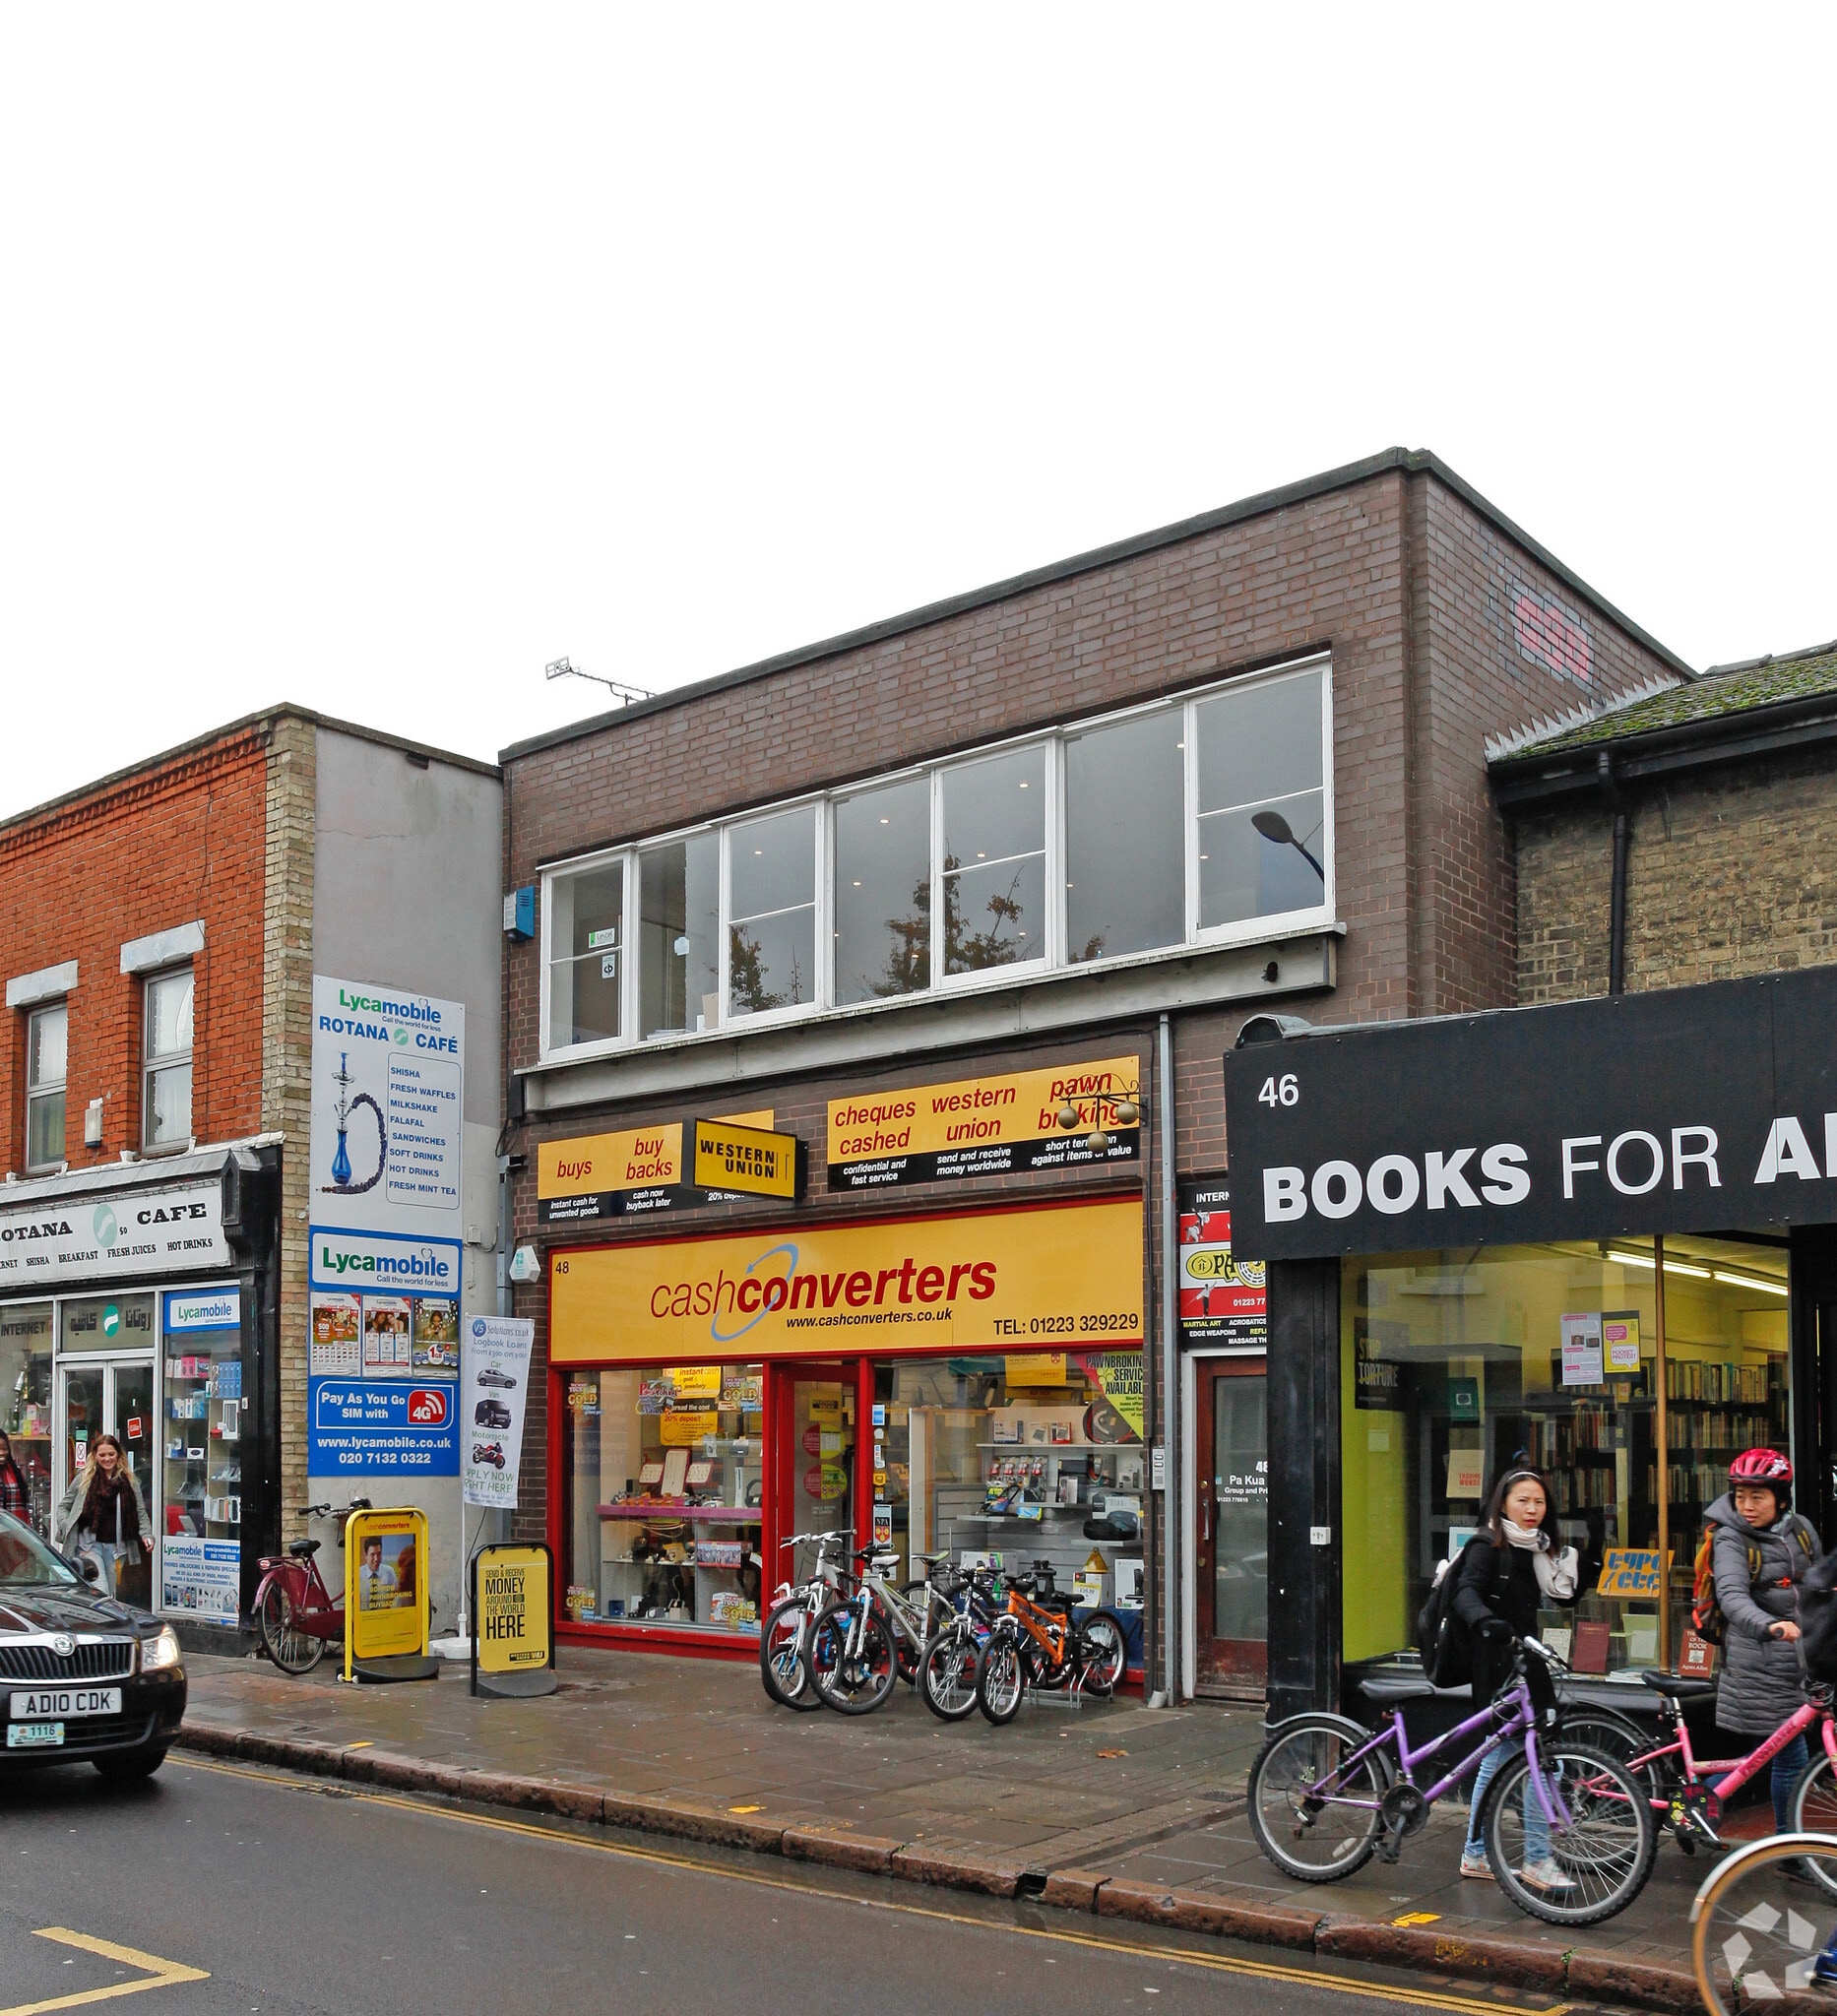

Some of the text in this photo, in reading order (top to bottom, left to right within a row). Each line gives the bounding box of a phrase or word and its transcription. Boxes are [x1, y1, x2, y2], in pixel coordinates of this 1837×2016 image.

[340, 988, 442, 1024] Lycamobile
[319, 1016, 458, 1053] ROTANA CAFÉ
[390, 1066, 420, 1079] SHISHA
[390, 1083, 456, 1101] FRESH WAFFLES
[1258, 1073, 1299, 1107] 46
[390, 1100, 438, 1113] MILKSHAKE
[835, 1073, 1112, 1129] cheques western pawn
[390, 1116, 425, 1128] FALAFAL
[840, 1101, 1121, 1156] cashed union brking
[392, 1132, 446, 1147] SANDWICHES
[1045, 1137, 1070, 1152] short
[634, 1137, 665, 1158] buy
[700, 1139, 774, 1164] WESTERN
[390, 1148, 444, 1162] SOFT DRINKS
[937, 1148, 1012, 1165] send and receive
[1032, 1153, 1064, 1166] against
[1066, 1151, 1093, 1162] items
[1107, 1145, 1132, 1157] value
[389, 1165, 440, 1177] HOT DRINKS
[556, 1159, 593, 1180] buys
[626, 1158, 672, 1180] backs
[726, 1159, 774, 1178] UNION
[843, 1159, 907, 1175] confidential and
[936, 1160, 1012, 1175] money worldwide
[1262, 1113, 1837, 1225] BOOKS FOR A
[852, 1171, 898, 1185] fast service
[389, 1180, 457, 1196] FRESH MINT TEA
[633, 1190, 649, 1200] cash
[550, 1196, 599, 1210] instant cash for
[708, 1192, 723, 1201] 20%
[625, 1198, 671, 1212] buyback later
[549, 1206, 600, 1220] unwanted goods
[0, 1203, 208, 1242] OTANA CAFE
[119, 1227, 128, 1235] 50
[26, 1237, 213, 1267] SHISHA BREAKFAST FRESH JUICES HOT DRINKS
[323, 1246, 449, 1277] Lycamobile
[555, 1261, 570, 1274] 48
[391, 1275, 404, 1284] the
[404, 1277, 423, 1286] world
[434, 1279, 449, 1288] less
[650, 1258, 997, 1319] cashconverters
[1233, 1298, 1255, 1307] 01223
[178, 1302, 232, 1321] Lycamobile
[786, 1307, 952, 1329] www.cashconverters.co.uk
[1, 1321, 45, 1337] INTERNET
[474, 1323, 484, 1334] VS
[993, 1313, 1139, 1336] TEL: 01223 329229
[474, 1338, 504, 1348] Logbook
[679, 1367, 704, 1376] instant
[321, 1391, 406, 1406] Pay As You Go
[568, 1394, 598, 1405] GOLD
[723, 1389, 757, 1401] GOLD
[342, 1406, 431, 1419] SIM with 4G
[317, 1436, 451, 1450] www.lycamobile.co.uk
[339, 1452, 431, 1464] 020 7132 0322
[491, 1472, 514, 1481] NOW
[1230, 1475, 1265, 1485] Pa Kua
[1224, 1486, 1244, 1495] Group
[366, 1522, 410, 1531] cashconverters
[875, 1517, 889, 1526] NPA
[163, 1543, 202, 1555] Lycamobile
[485, 1568, 525, 1579] SEND RECEIVE
[485, 1576, 525, 1595] MONEY
[485, 1594, 512, 1605] AROUND
[565, 1596, 596, 1609] GOLD
[486, 1604, 525, 1616] THE WORLD
[722, 1607, 757, 1623] GOLD
[485, 1614, 525, 1640] HERE
[26, 1691, 111, 1715] AD10 CDK
[31, 1725, 55, 1735] 1116
